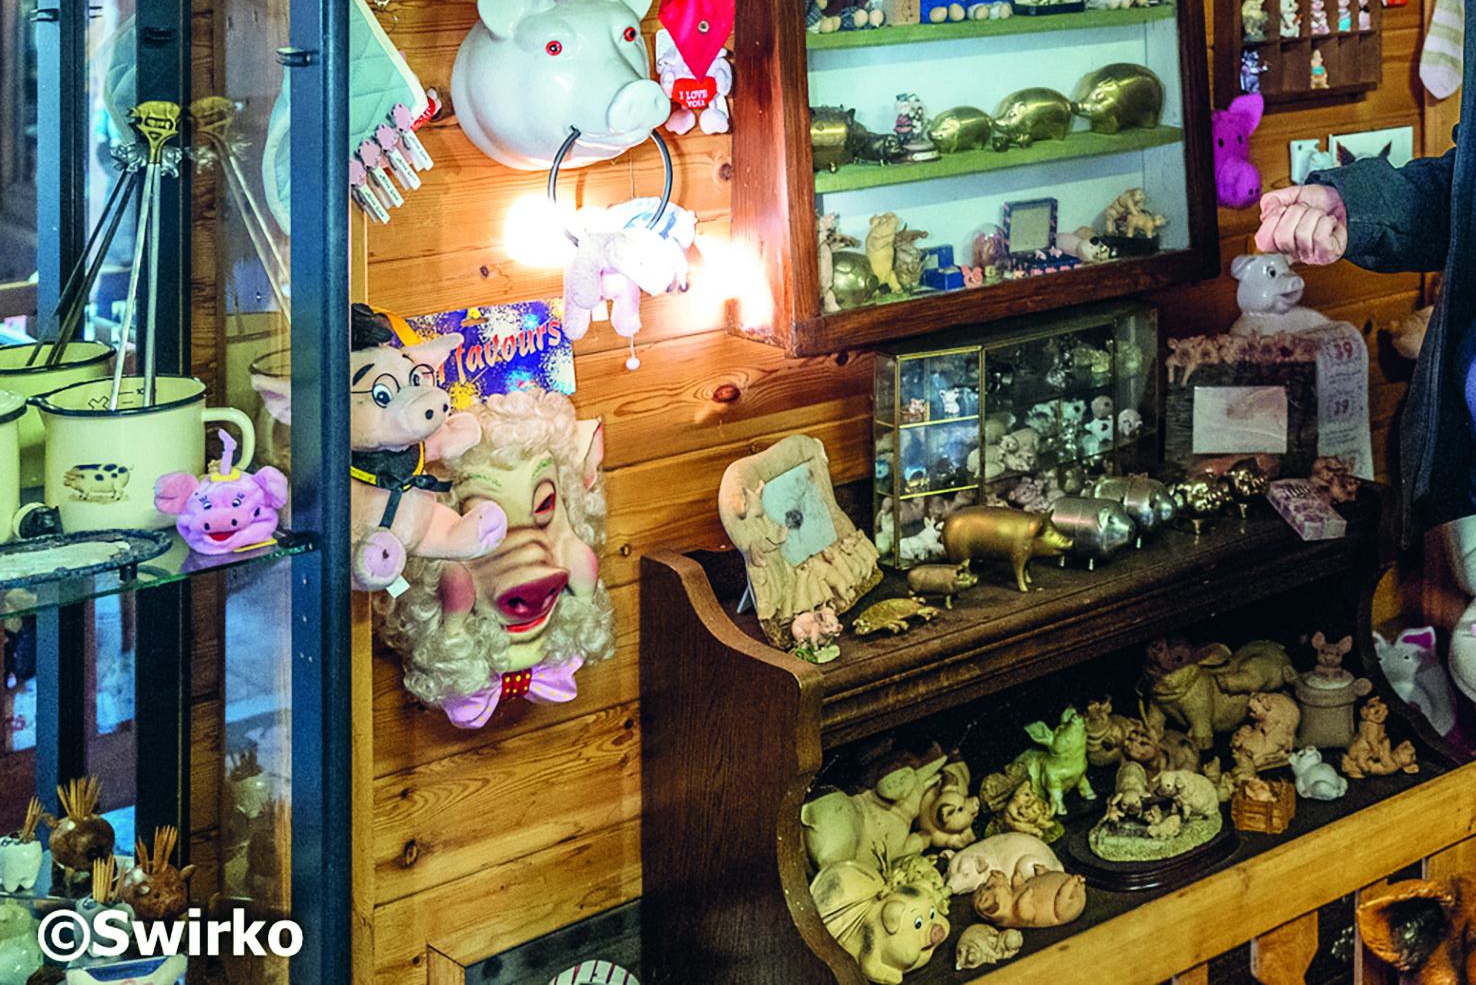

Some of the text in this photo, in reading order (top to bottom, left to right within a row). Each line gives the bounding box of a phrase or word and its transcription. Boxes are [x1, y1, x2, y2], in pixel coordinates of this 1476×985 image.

[679, 89, 708, 101] I LOVE
[687, 99, 706, 108] YOU
[455, 320, 561, 385] favours
